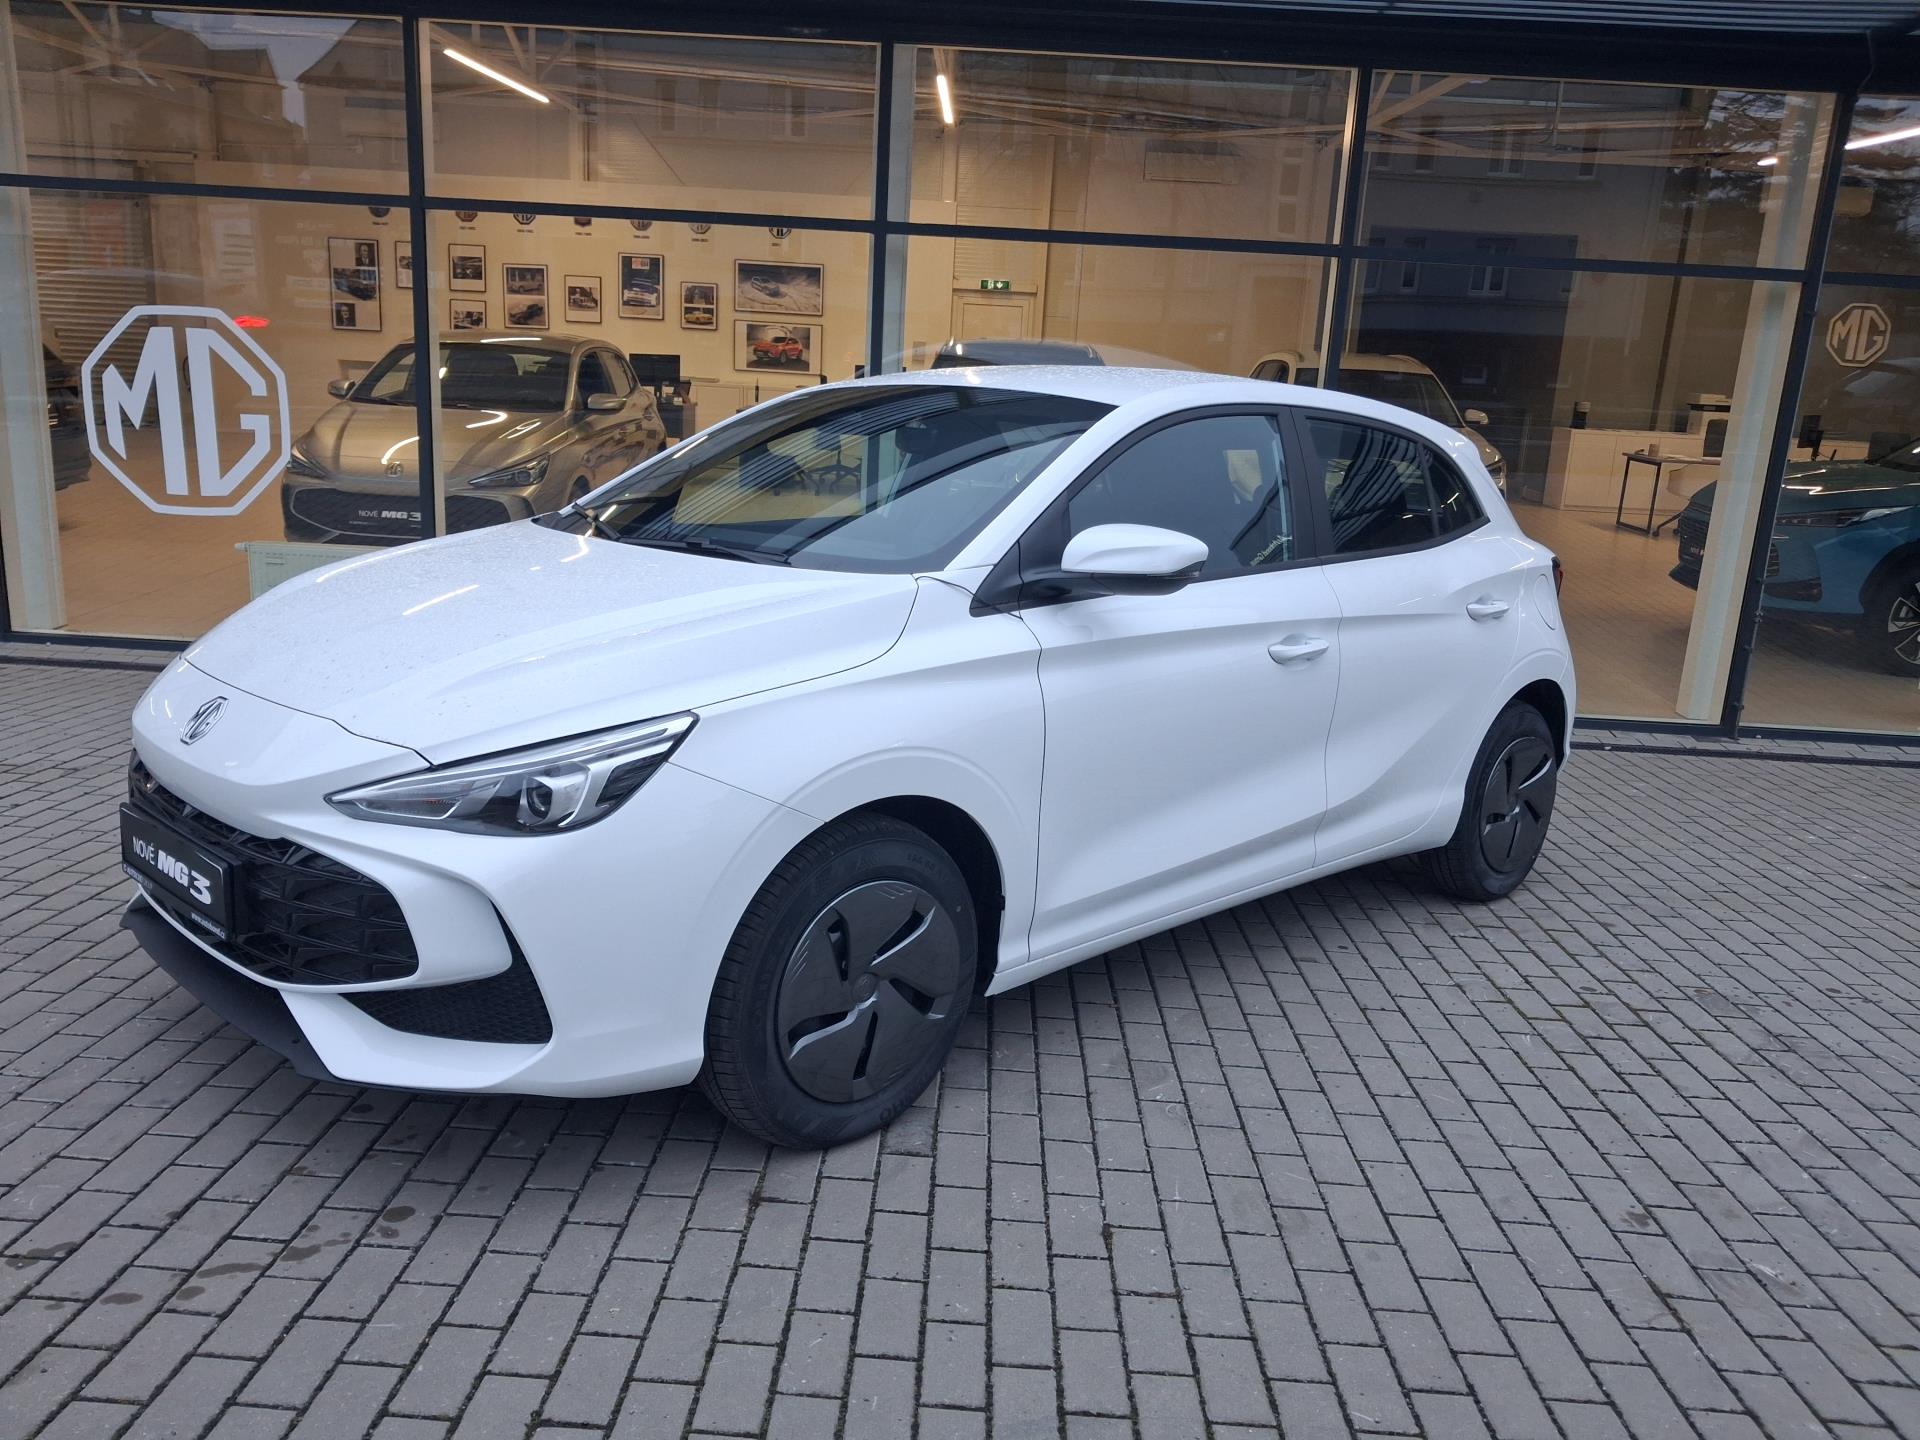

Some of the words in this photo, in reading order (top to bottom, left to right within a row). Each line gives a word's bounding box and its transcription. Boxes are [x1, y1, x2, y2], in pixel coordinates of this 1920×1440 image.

[1830, 308, 1887, 362] MG
[101, 325, 272, 497] MG
[132, 835, 155, 866] NOVÉ
